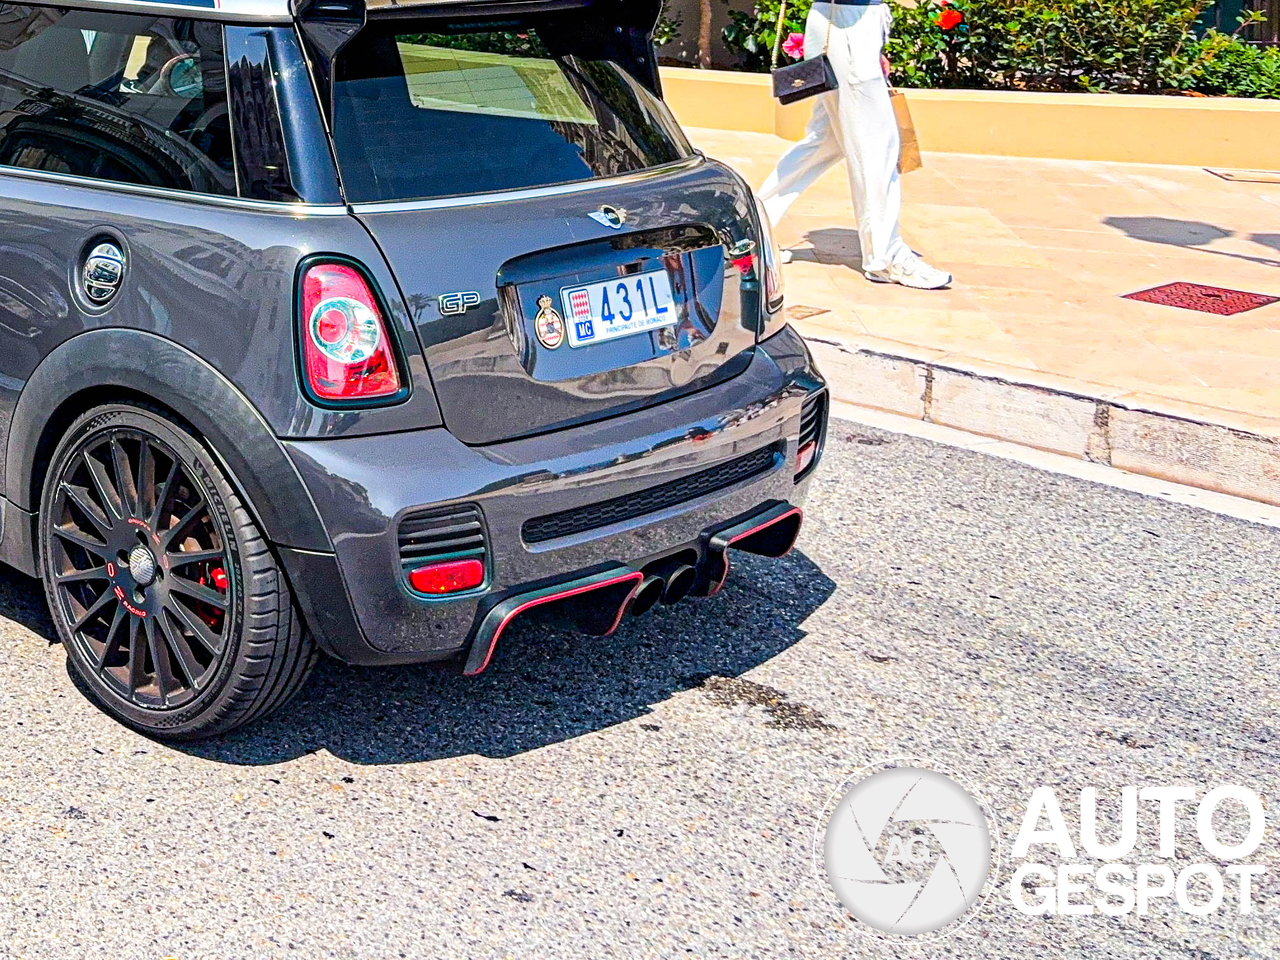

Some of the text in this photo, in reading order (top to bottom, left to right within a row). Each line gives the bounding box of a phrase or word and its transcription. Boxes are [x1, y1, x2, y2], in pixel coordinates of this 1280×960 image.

[438, 291, 480, 315] GP
[601, 276, 669, 325] 431L
[578, 322, 592, 337] MC
[202, 475, 238, 553] MICHELIN
